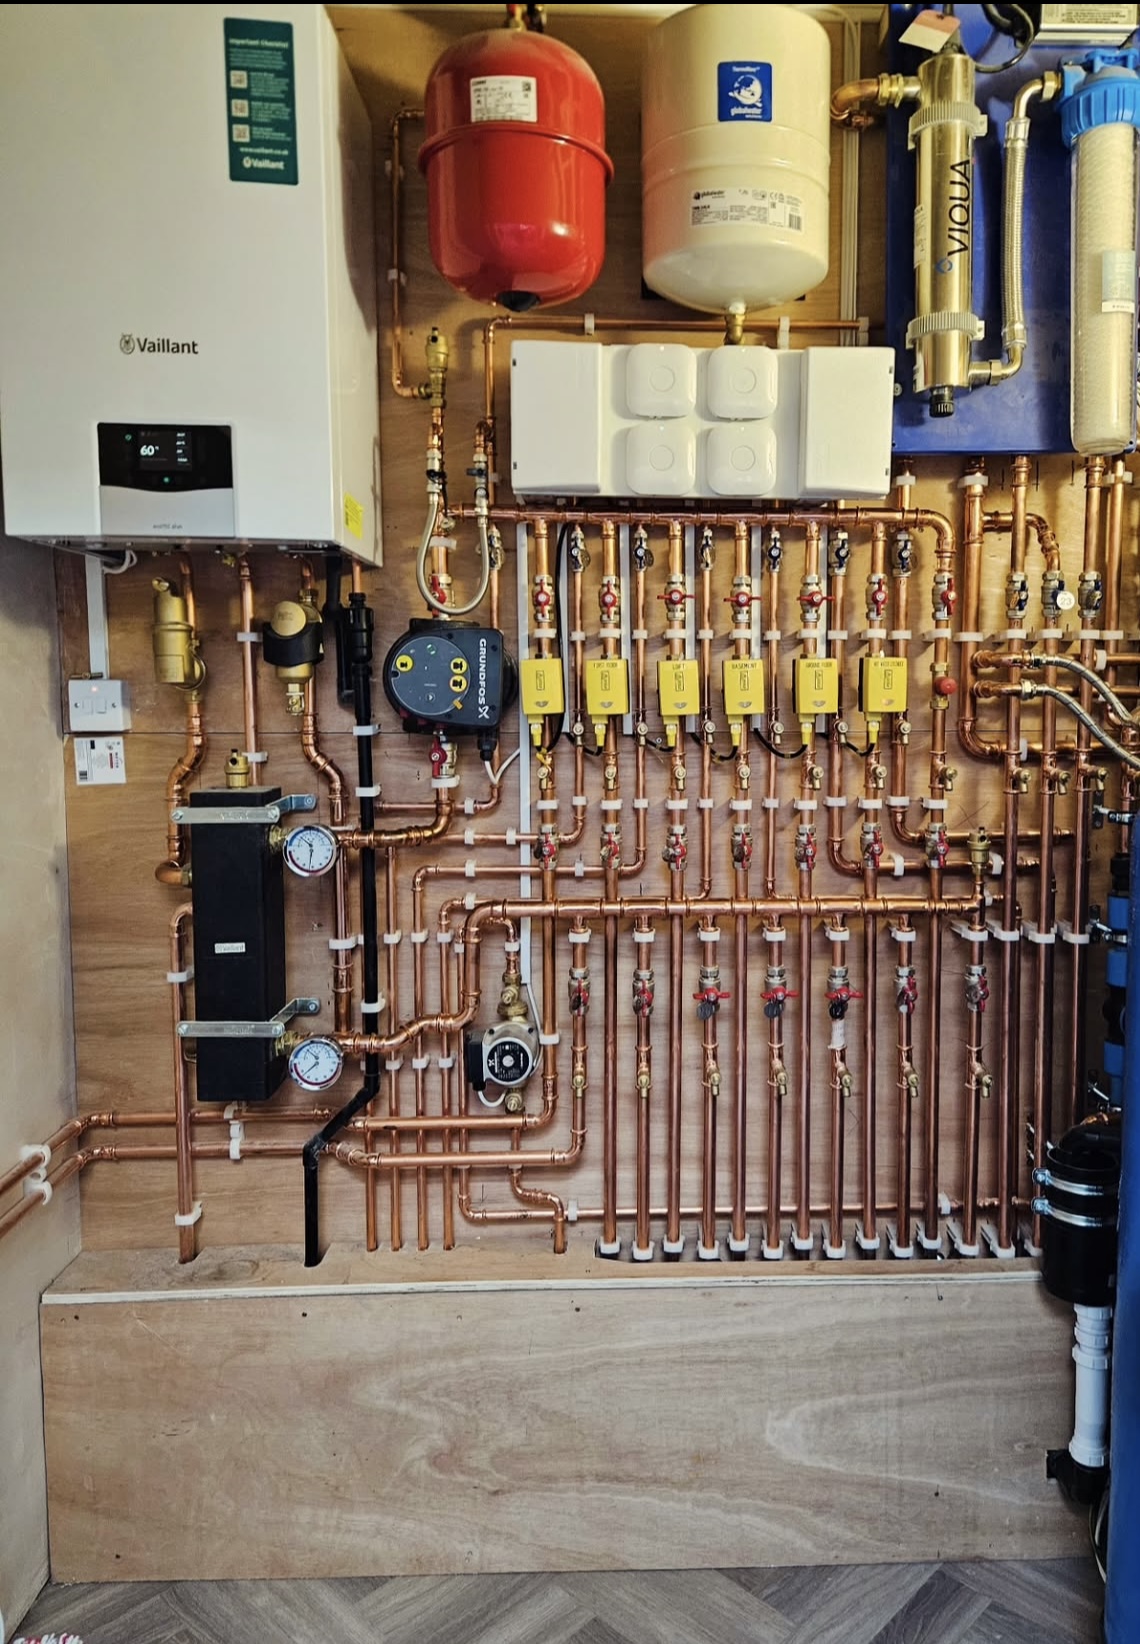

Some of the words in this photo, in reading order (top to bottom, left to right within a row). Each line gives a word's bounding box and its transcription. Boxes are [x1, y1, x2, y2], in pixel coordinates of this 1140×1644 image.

[947, 159, 970, 257] VIQUA
[137, 337, 199, 355] Vaillant
[479, 638, 488, 706] GRUNDFOS
[731, 662, 757, 670] BASEMENT
